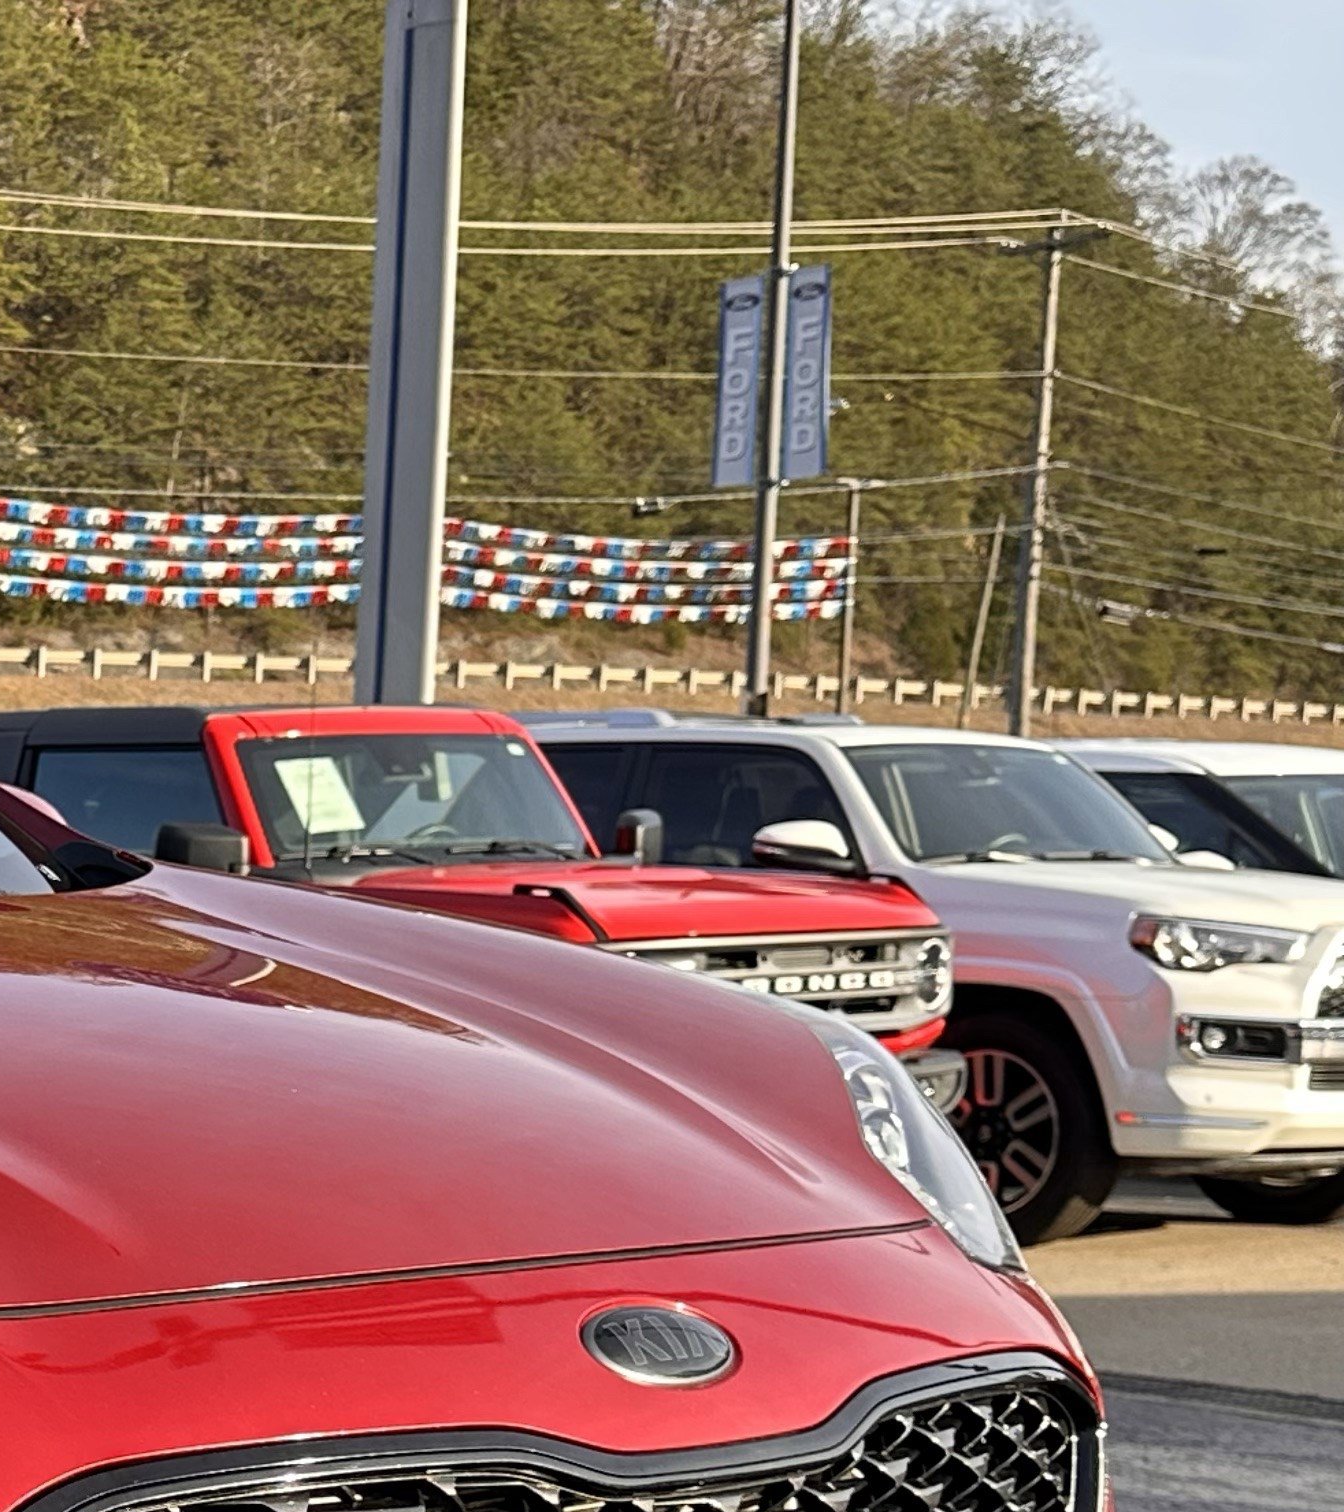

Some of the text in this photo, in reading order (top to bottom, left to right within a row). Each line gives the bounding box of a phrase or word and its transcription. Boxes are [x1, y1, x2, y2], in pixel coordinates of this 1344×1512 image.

[720, 325, 756, 464] FORD
[792, 314, 824, 456] FORD
[741, 970, 896, 995] RONCO
[602, 1312, 731, 1366] KIA
